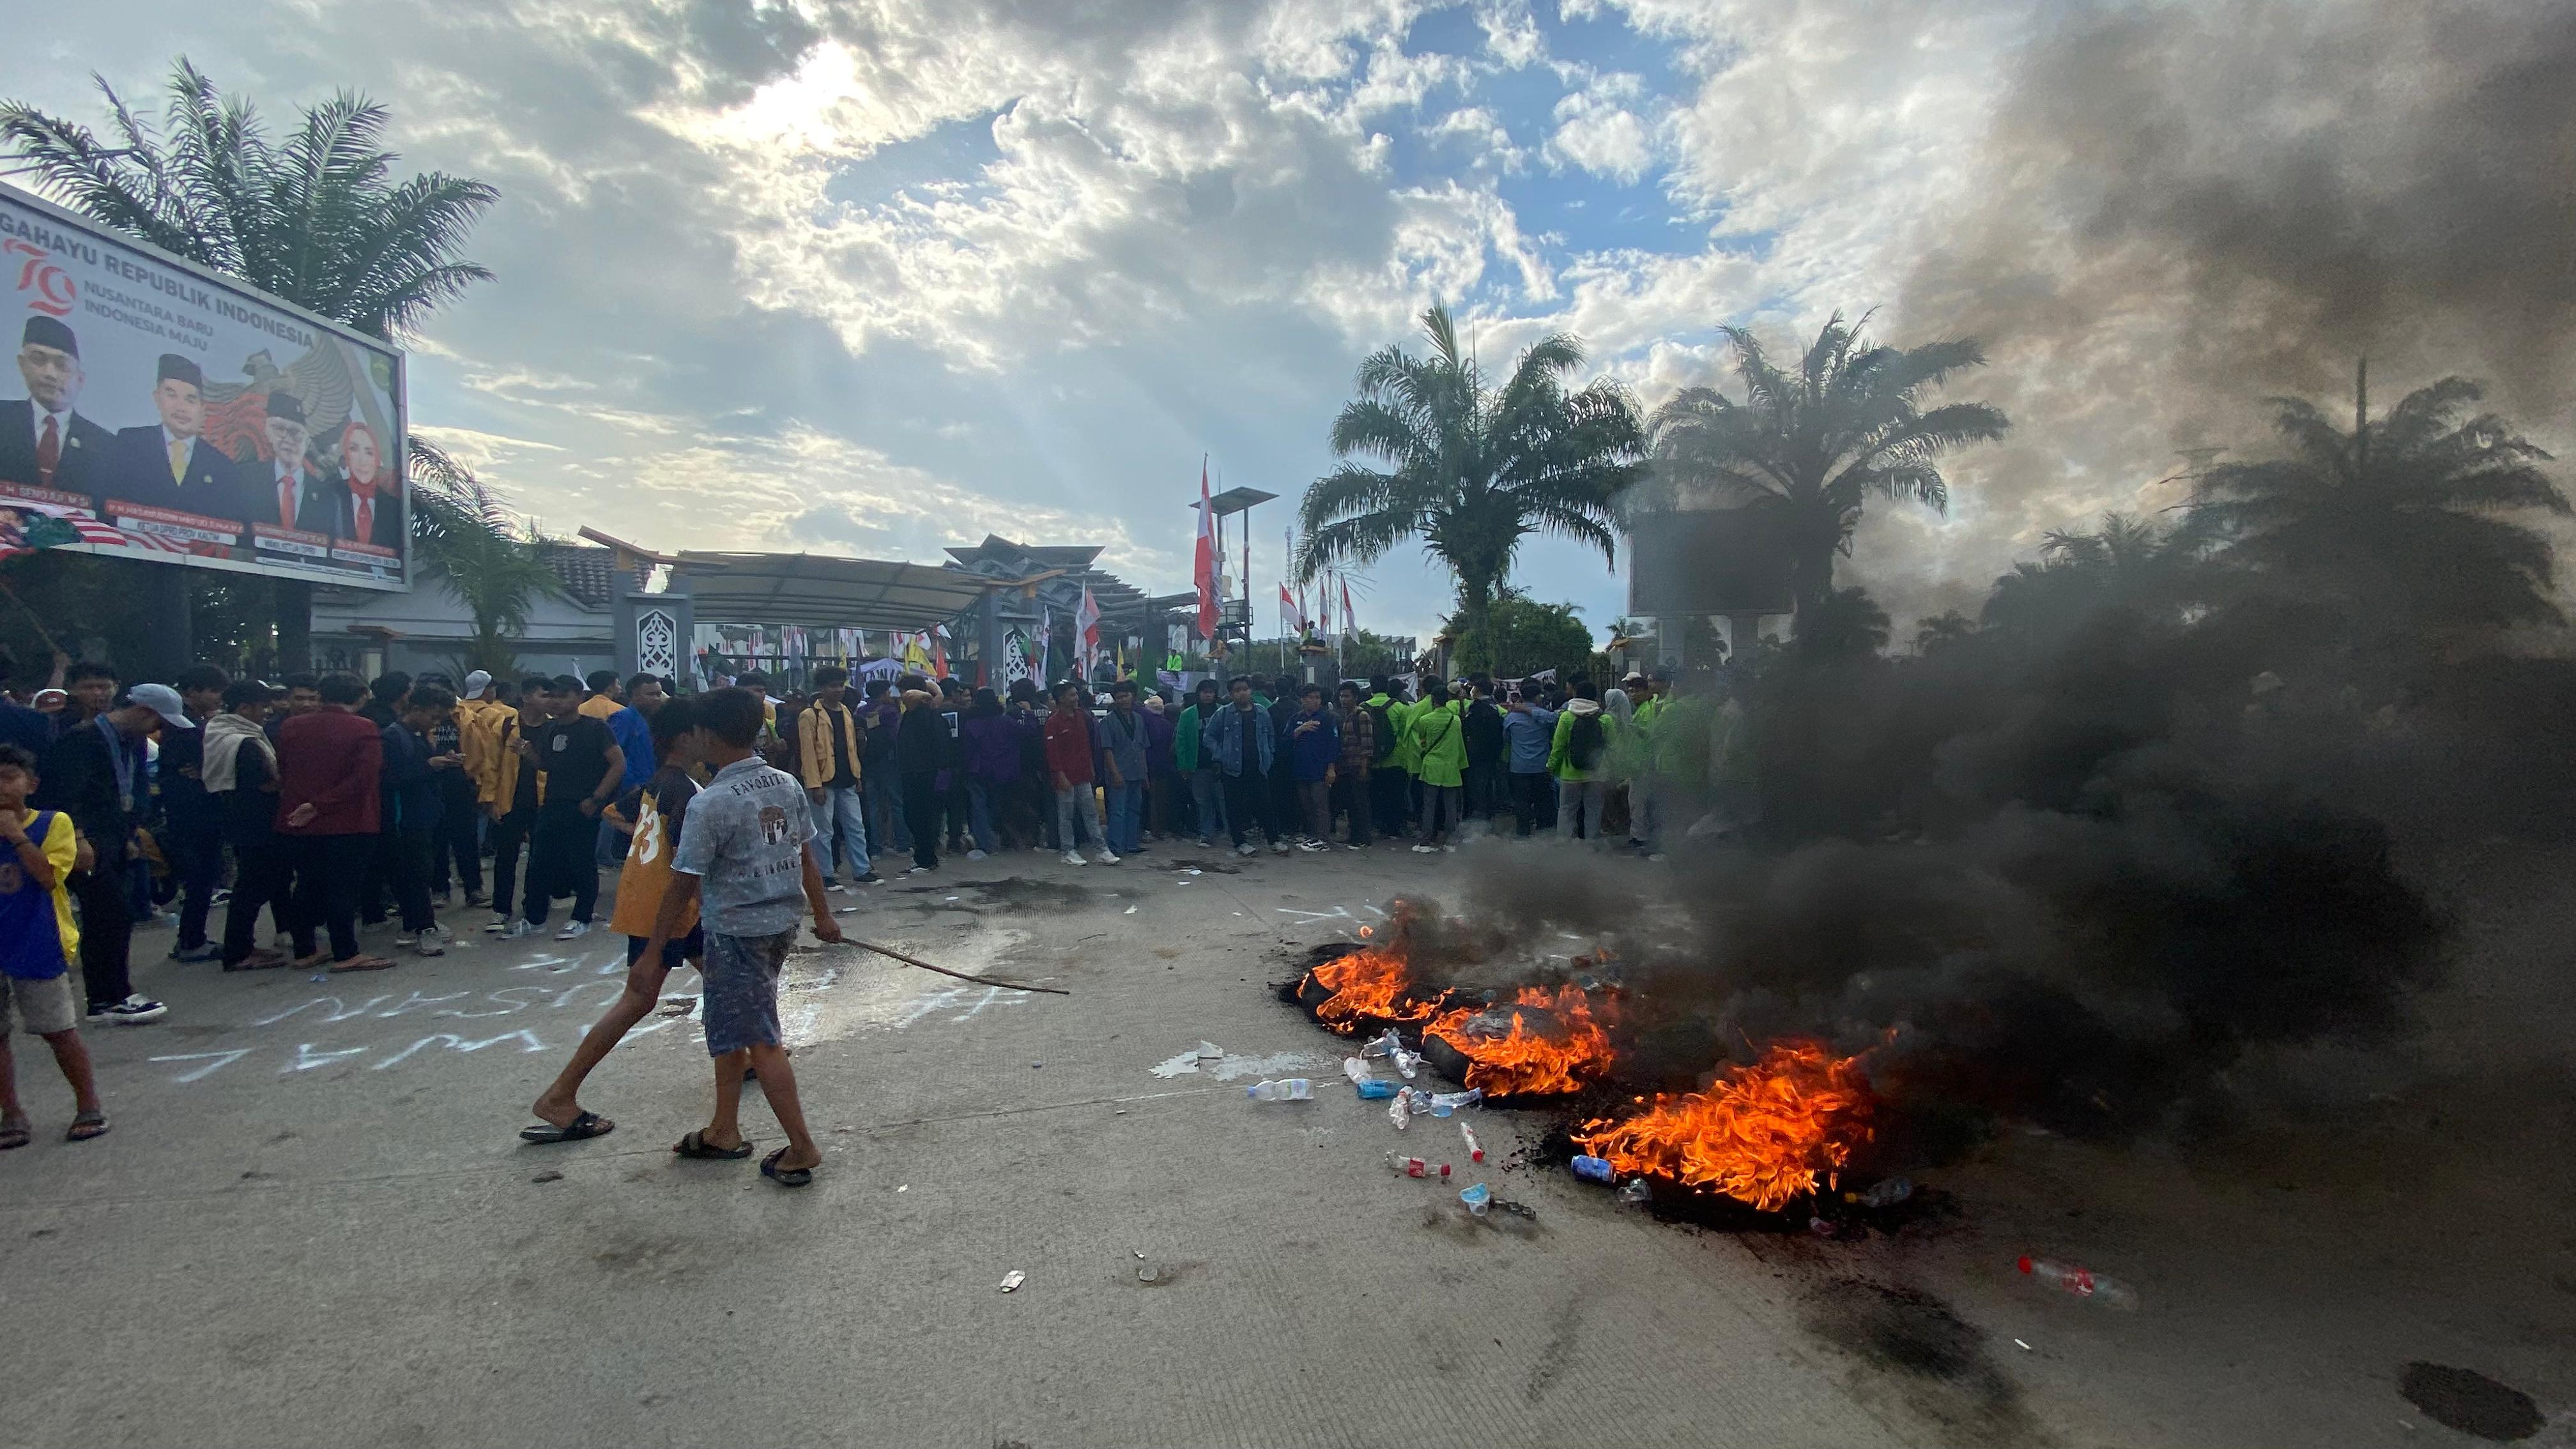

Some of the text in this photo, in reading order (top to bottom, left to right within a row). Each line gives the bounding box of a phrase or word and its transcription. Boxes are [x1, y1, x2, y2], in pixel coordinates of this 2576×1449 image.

[83, 280, 213, 337] NUSANTARA BARU
[84, 299, 208, 351] INDONESIA MAJU
[104, 254, 211, 311] REPUBLIK
[215, 298, 314, 349] INDONESIA
[730, 772, 788, 796] FAVORITE
